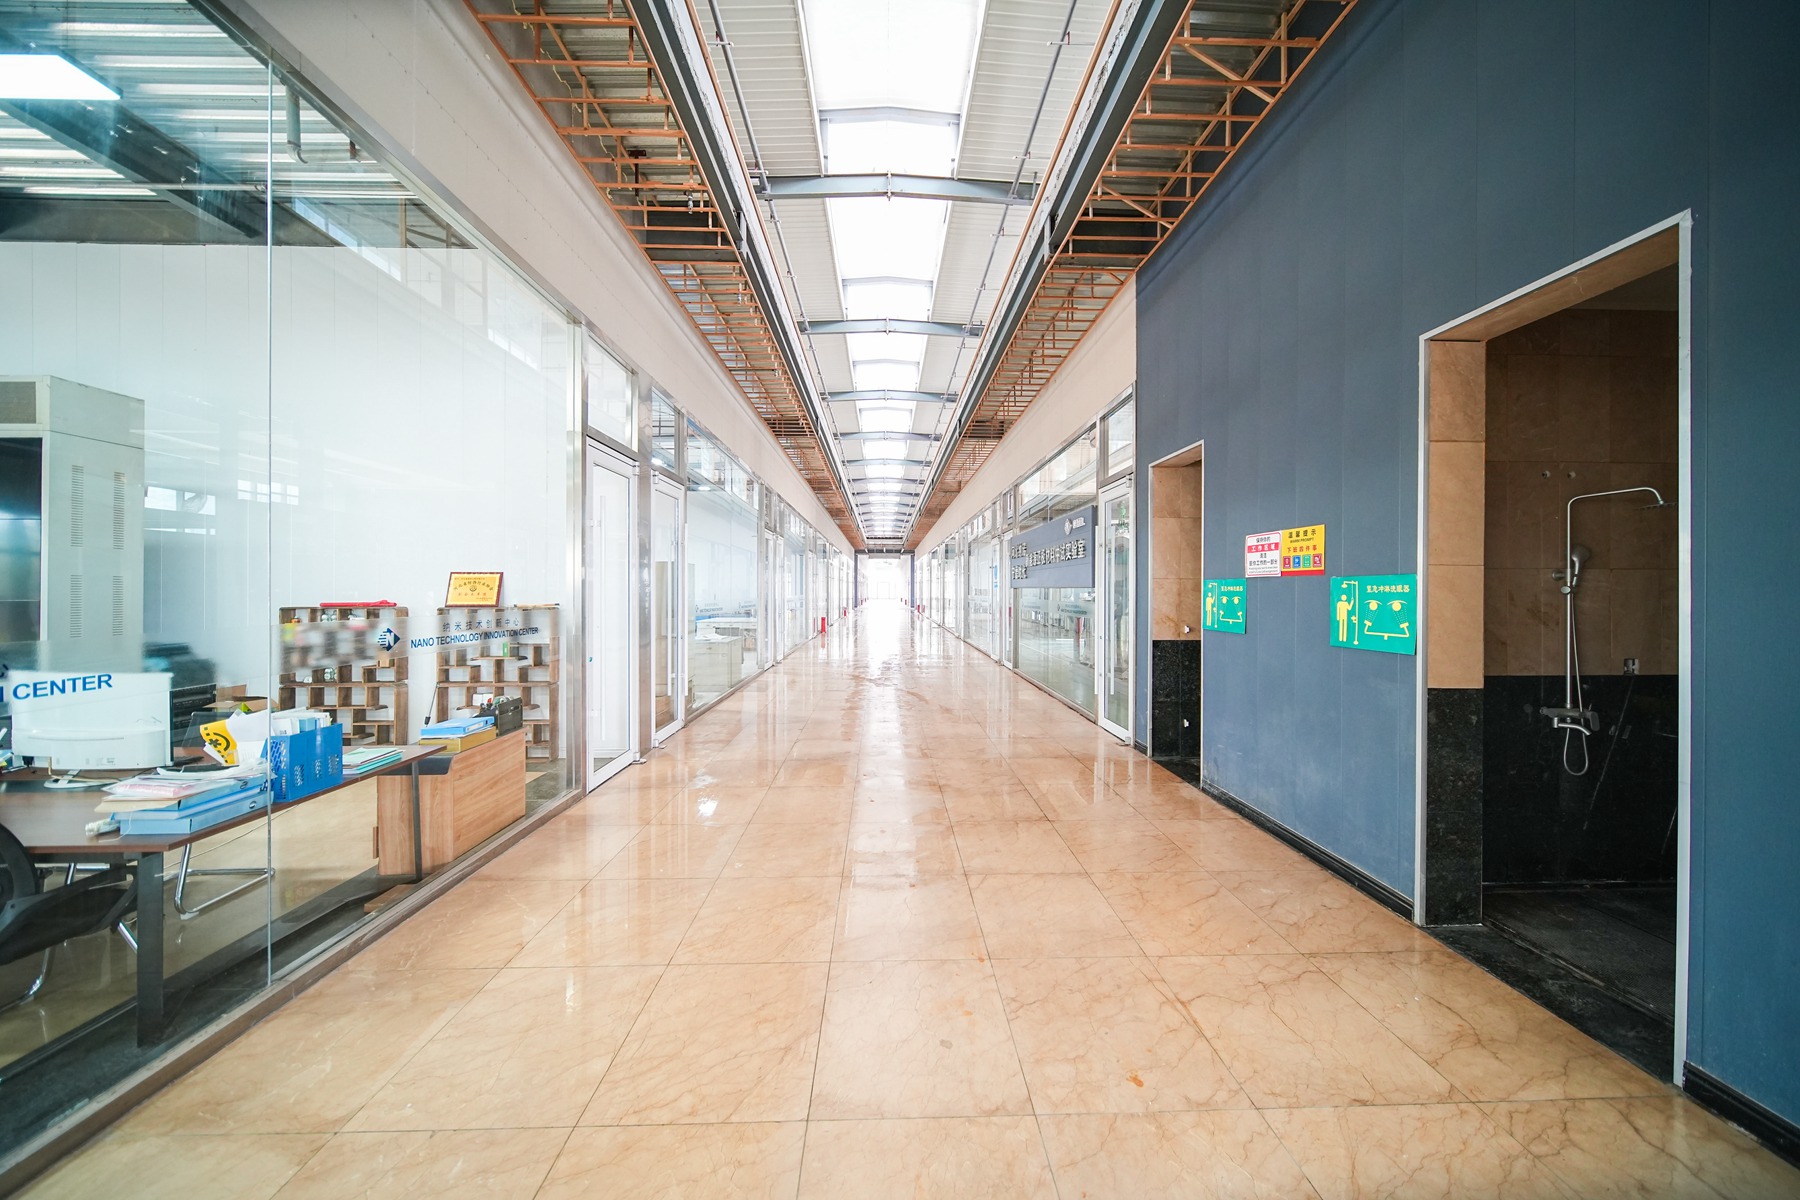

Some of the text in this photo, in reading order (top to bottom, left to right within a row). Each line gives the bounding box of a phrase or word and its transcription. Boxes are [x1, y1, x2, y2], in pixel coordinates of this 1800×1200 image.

[442, 617, 520, 633] 纳米技术创新中心
[410, 626, 539, 649] NANO TECHNOLOGY INNOVATION CENTER
[12, 673, 113, 700] CENTER
